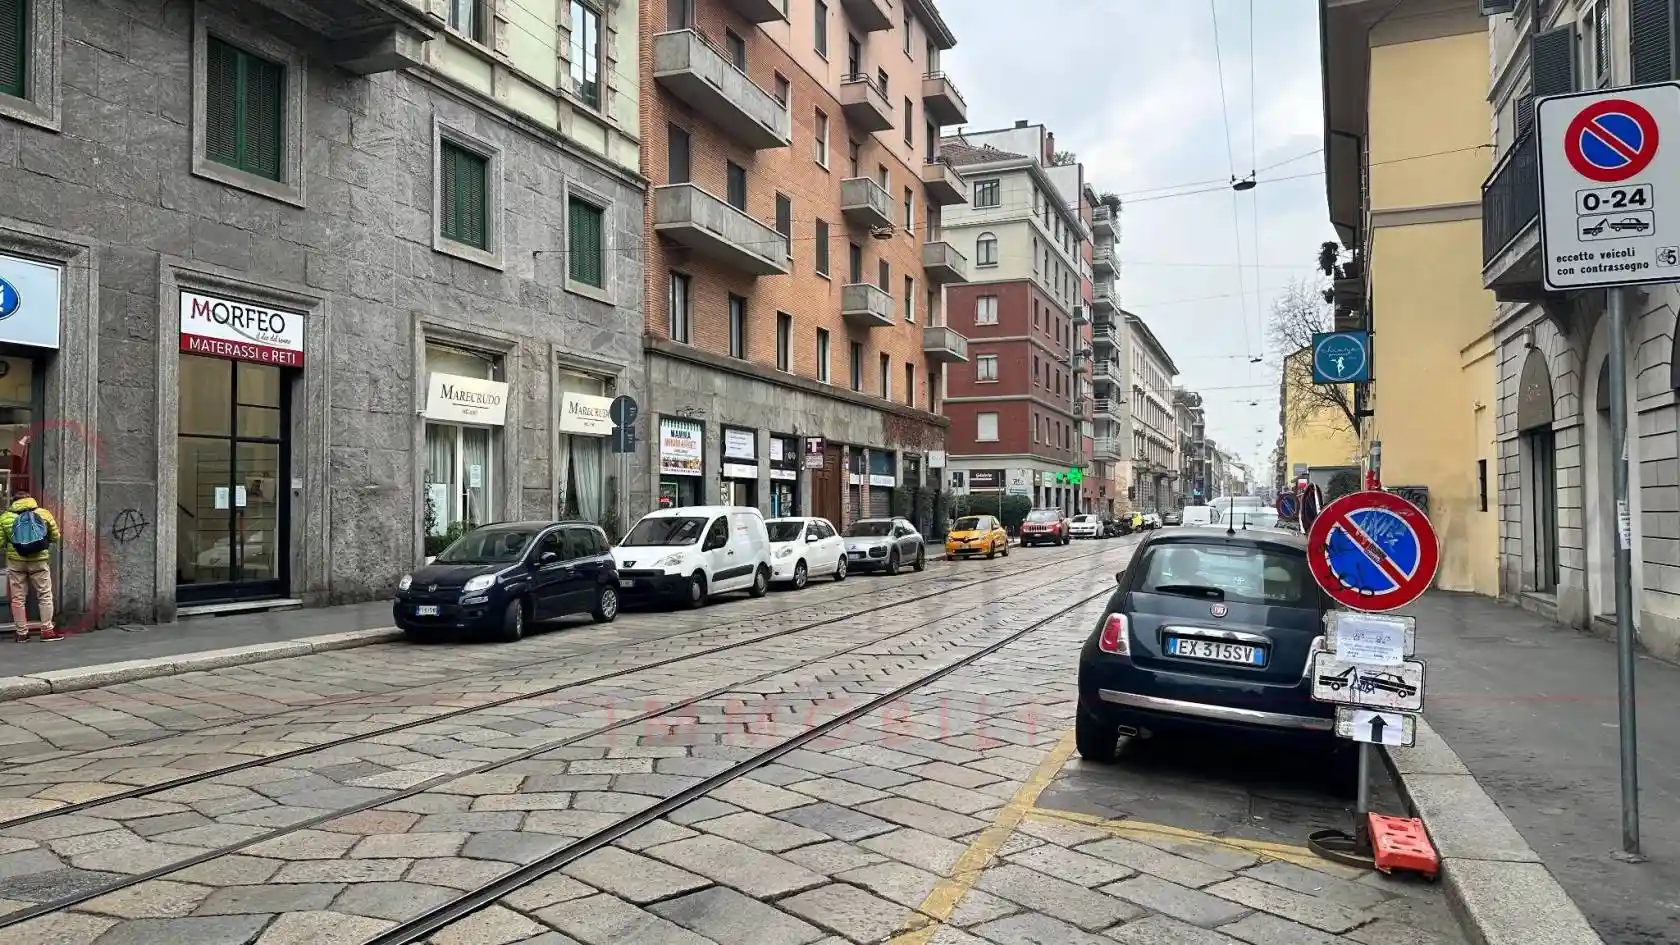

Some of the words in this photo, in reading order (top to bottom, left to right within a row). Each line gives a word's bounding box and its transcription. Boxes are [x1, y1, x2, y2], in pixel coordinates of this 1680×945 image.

[1583, 188, 1646, 211] 0-24
[1556, 252, 1594, 263] eccetto
[1600, 247, 1635, 259] veicoli
[1557, 267, 1575, 275] con
[1580, 262, 1649, 273] contrassegno
[190, 298, 285, 334] MORFEO
[189, 337, 259, 359] MATERASSI
[262, 352, 269, 360] e
[271, 350, 296, 365] RETI
[1179, 640, 1197, 656] EX
[1203, 642, 1253, 662] 315SV
